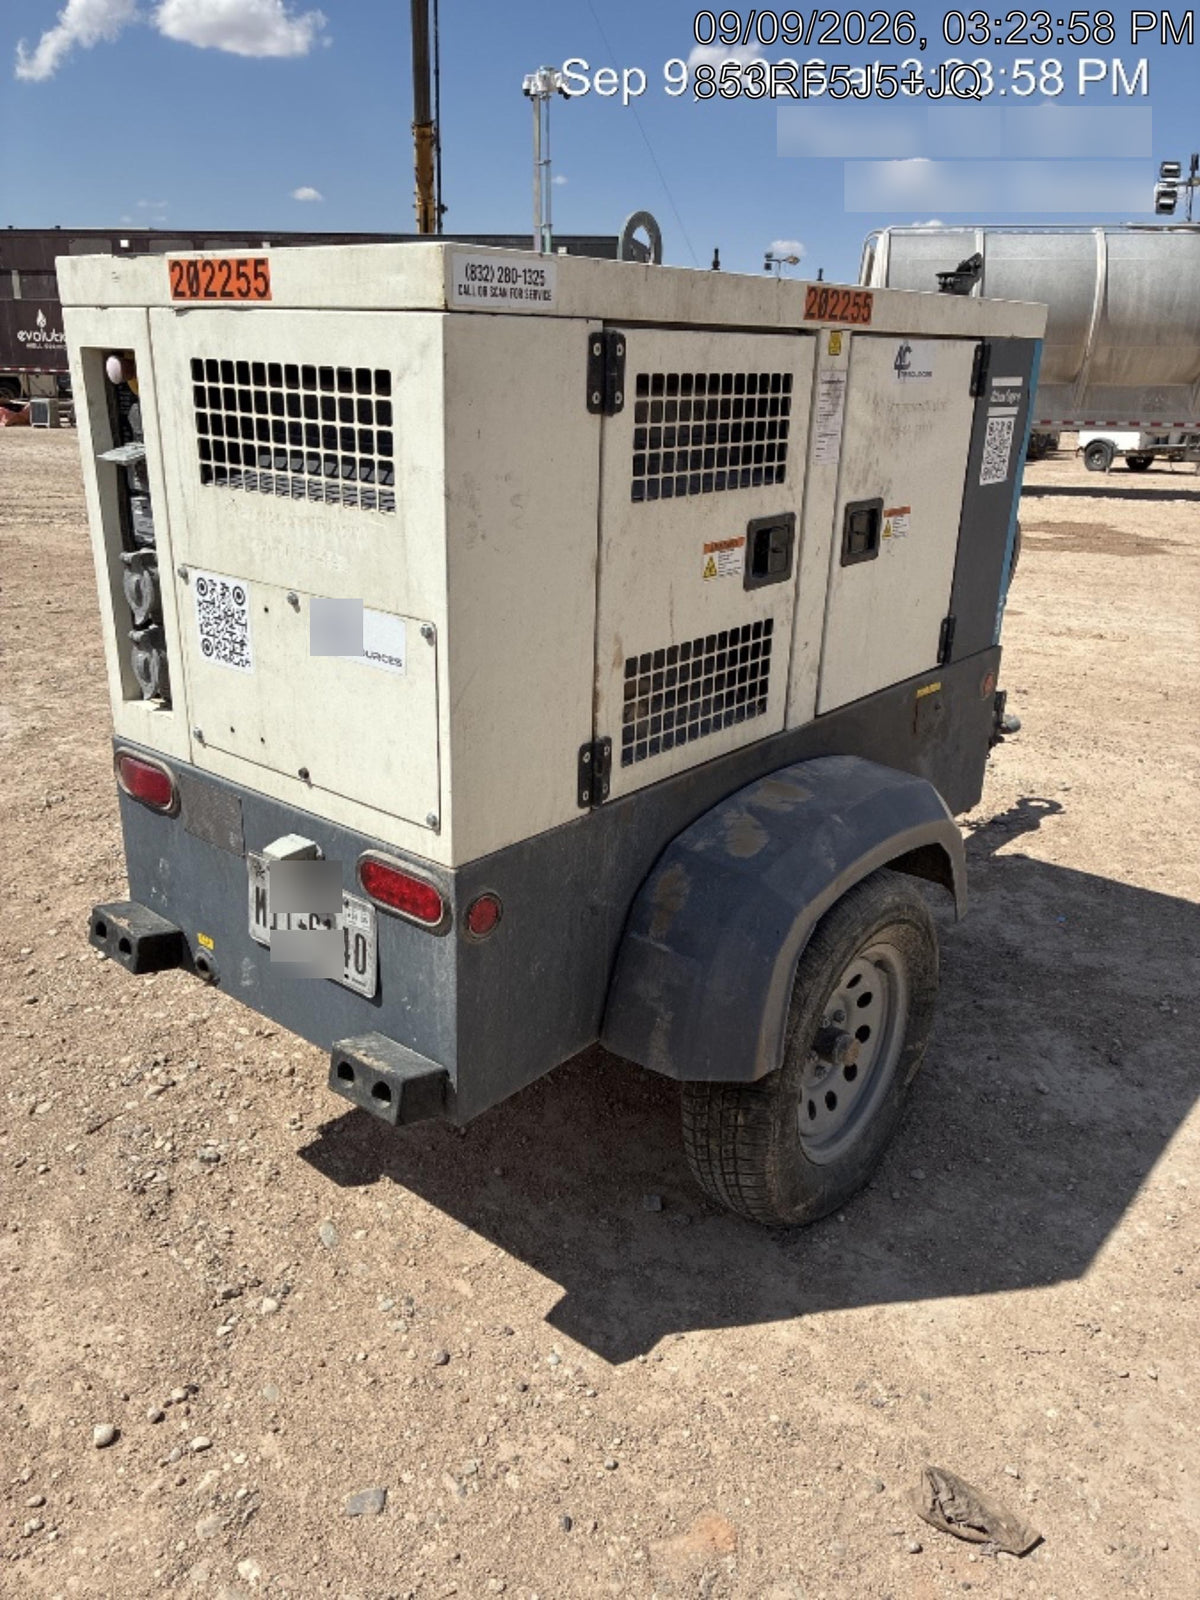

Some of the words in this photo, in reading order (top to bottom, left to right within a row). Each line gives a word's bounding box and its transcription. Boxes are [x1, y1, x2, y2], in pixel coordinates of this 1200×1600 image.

[170, 259, 270, 298] 202255
[465, 262, 495, 283] (832)
[497, 266, 546, 287] 280-1325
[805, 286, 873, 324] 202255
